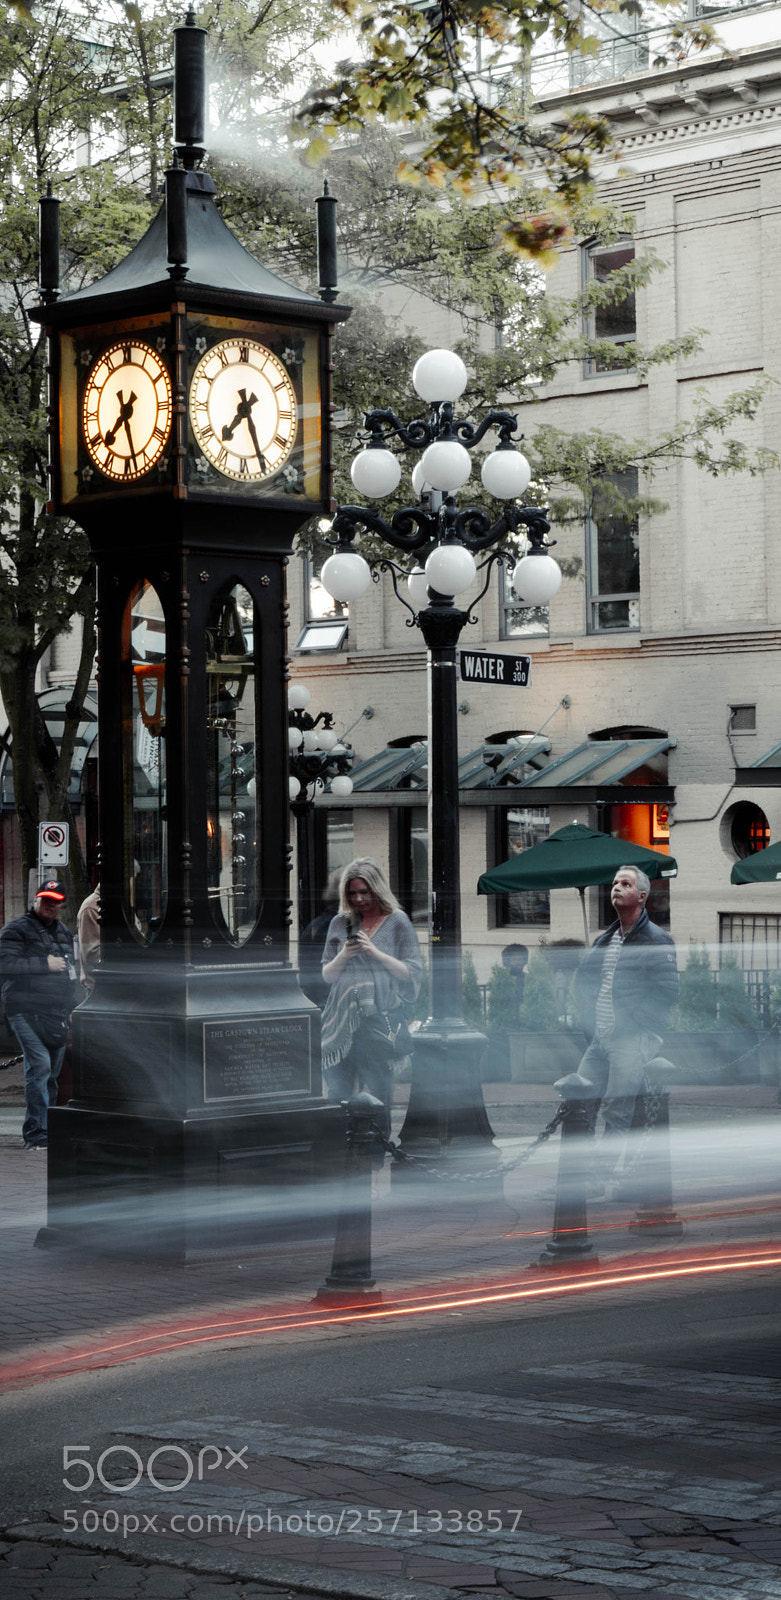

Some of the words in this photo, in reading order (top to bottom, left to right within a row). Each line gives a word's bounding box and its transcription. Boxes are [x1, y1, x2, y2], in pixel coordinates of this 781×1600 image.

[464, 655, 504, 680] WATER
[515, 660, 523, 671] ST
[512, 671, 526, 682] 300
[210, 1030, 224, 1038] THE
[225, 1028, 258, 1037] GASTOWN
[259, 1026, 280, 1034] STEAM
[280, 1024, 303, 1032] CLOCK
